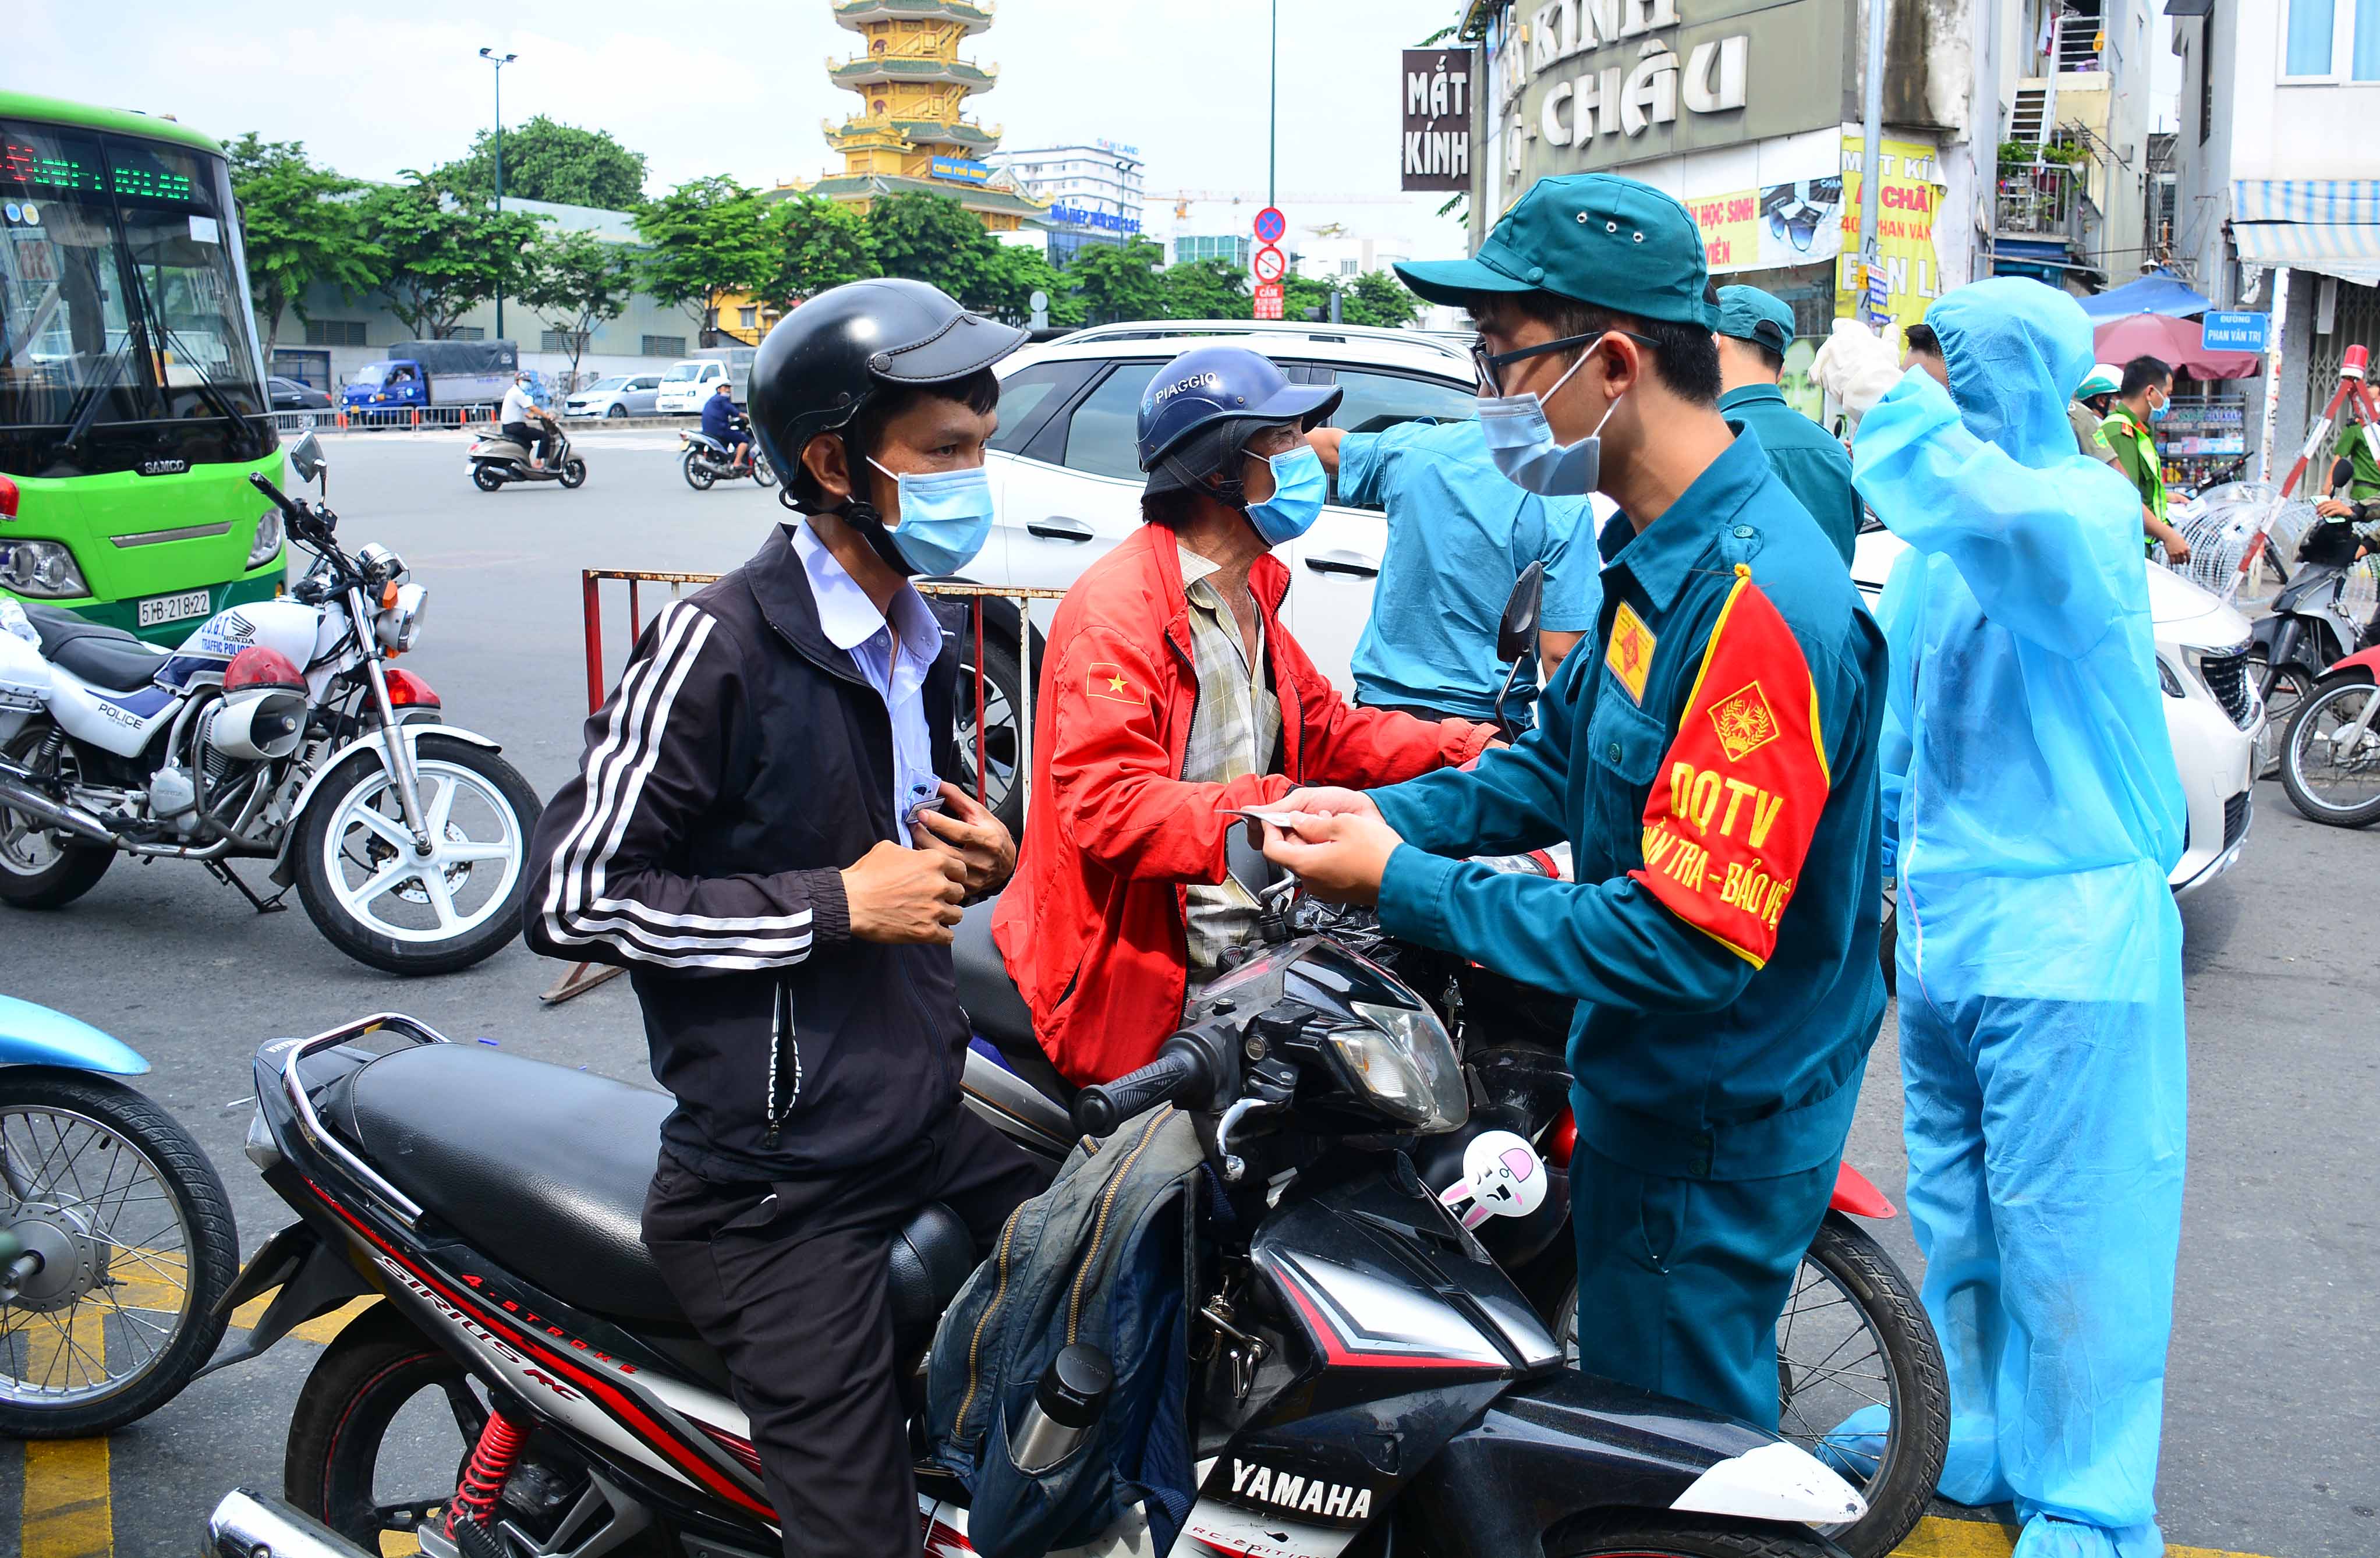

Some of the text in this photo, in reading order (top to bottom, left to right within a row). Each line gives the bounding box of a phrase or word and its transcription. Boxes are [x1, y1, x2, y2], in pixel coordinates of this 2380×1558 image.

[1408, 55, 1467, 119] MẮT
[1542, 36, 1748, 148] CHÂU
[1405, 121, 1468, 179] KÍNH
[1842, 150, 1895, 176] MT
[1701, 202, 1724, 231] HỌC
[1727, 197, 1754, 223] SINH
[1882, 185, 1932, 212] CHÂ
[2208, 330, 2229, 341] PHAN
[2230, 328, 2247, 342] VĂN
[1155, 372, 1218, 404] PIAGGIO
[145, 460, 185, 473] SAMCO
[201, 638, 222, 652] TRAFFIC
[224, 635, 256, 645] HONDA
[98, 703, 143, 730] POLICE
[1670, 762, 1784, 848] DQTV
[1663, 838, 1709, 893] TRA
[1720, 858, 1769, 913] BẢO
[373, 1255, 584, 1403] SIRIUS RC
[1231, 1458, 1372, 1518] YAMAHA
